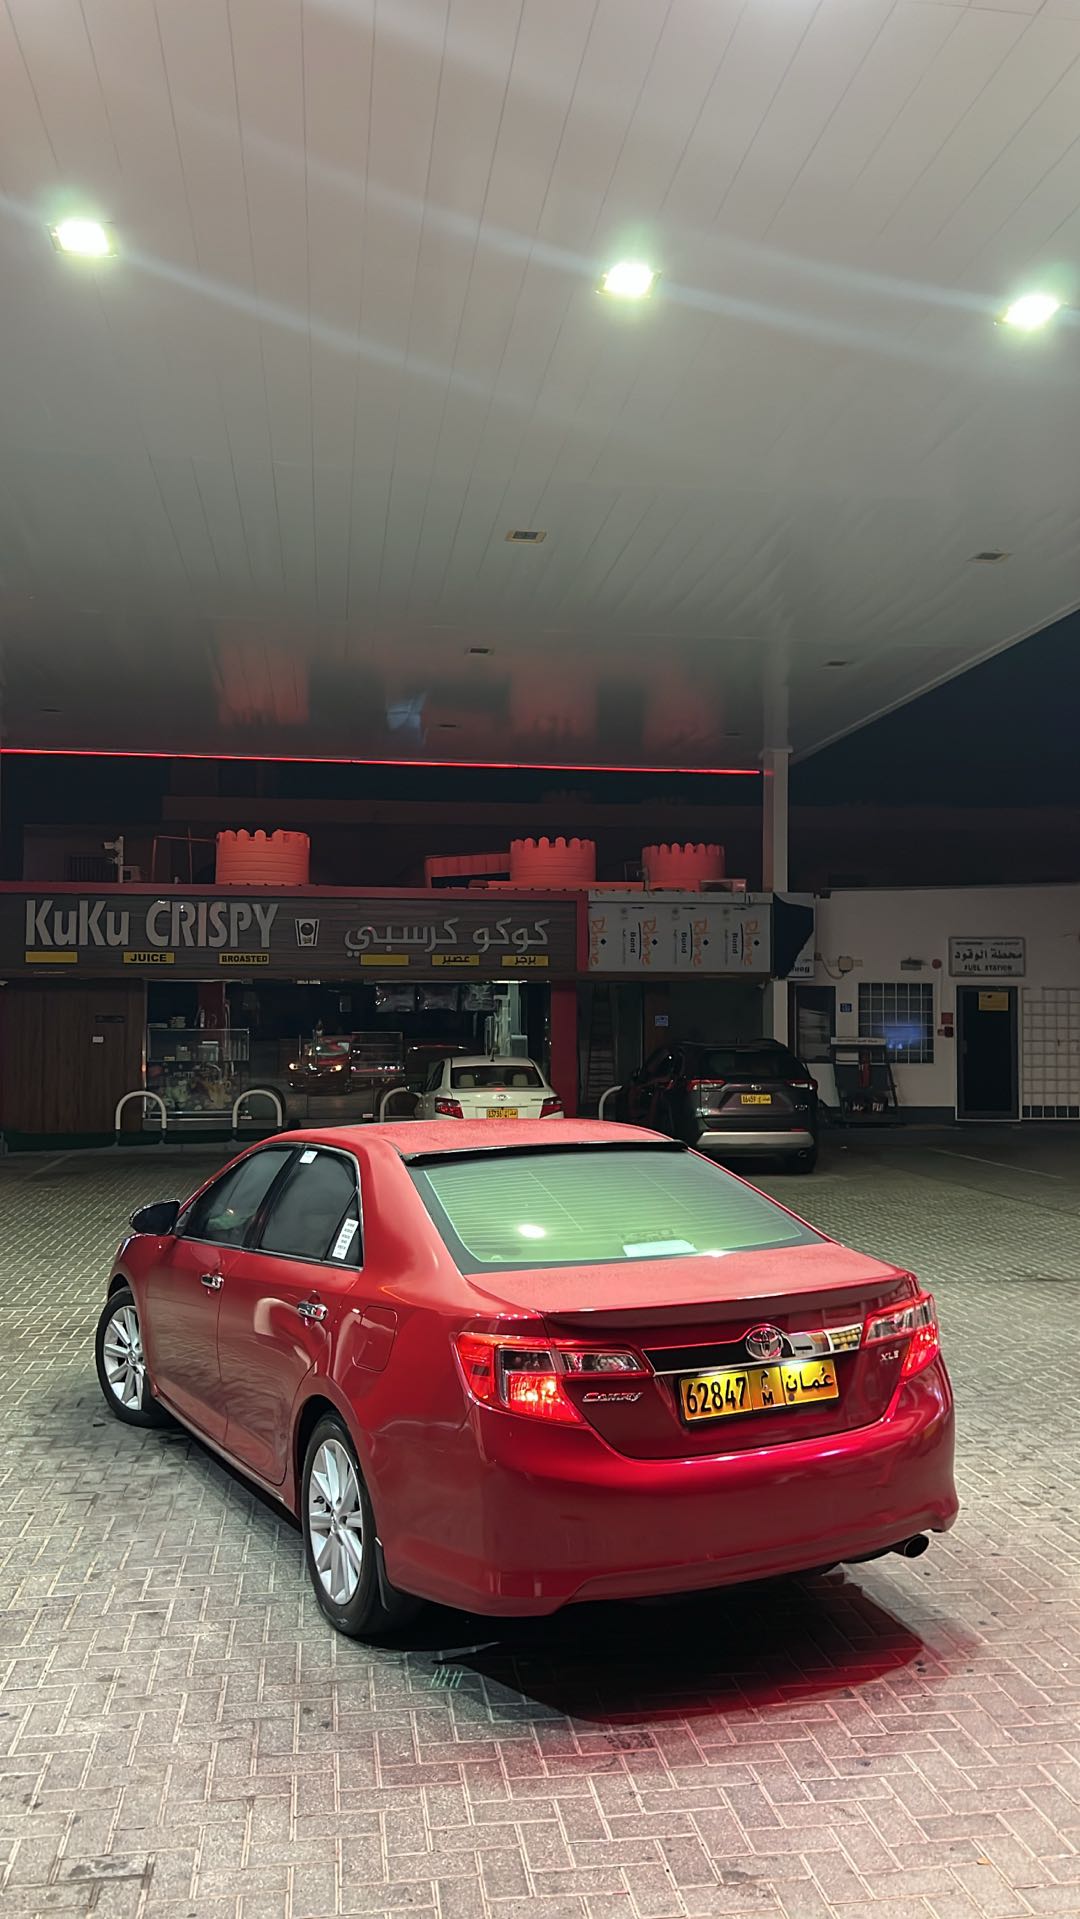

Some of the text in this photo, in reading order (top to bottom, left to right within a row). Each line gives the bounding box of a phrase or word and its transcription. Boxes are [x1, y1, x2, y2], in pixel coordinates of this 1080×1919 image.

[26, 900, 279, 948] KuKu CRISPY
[344, 917, 550, 957] كوكو كرسبي
[130, 953, 167, 962] JUICE
[221, 955, 268, 963] BROASTED
[955, 948, 987, 961] الوقود
[880, 1350, 899, 1362] XLE
[686, 1376, 746, 1413] 62847
[762, 1391, 774, 1405] M
